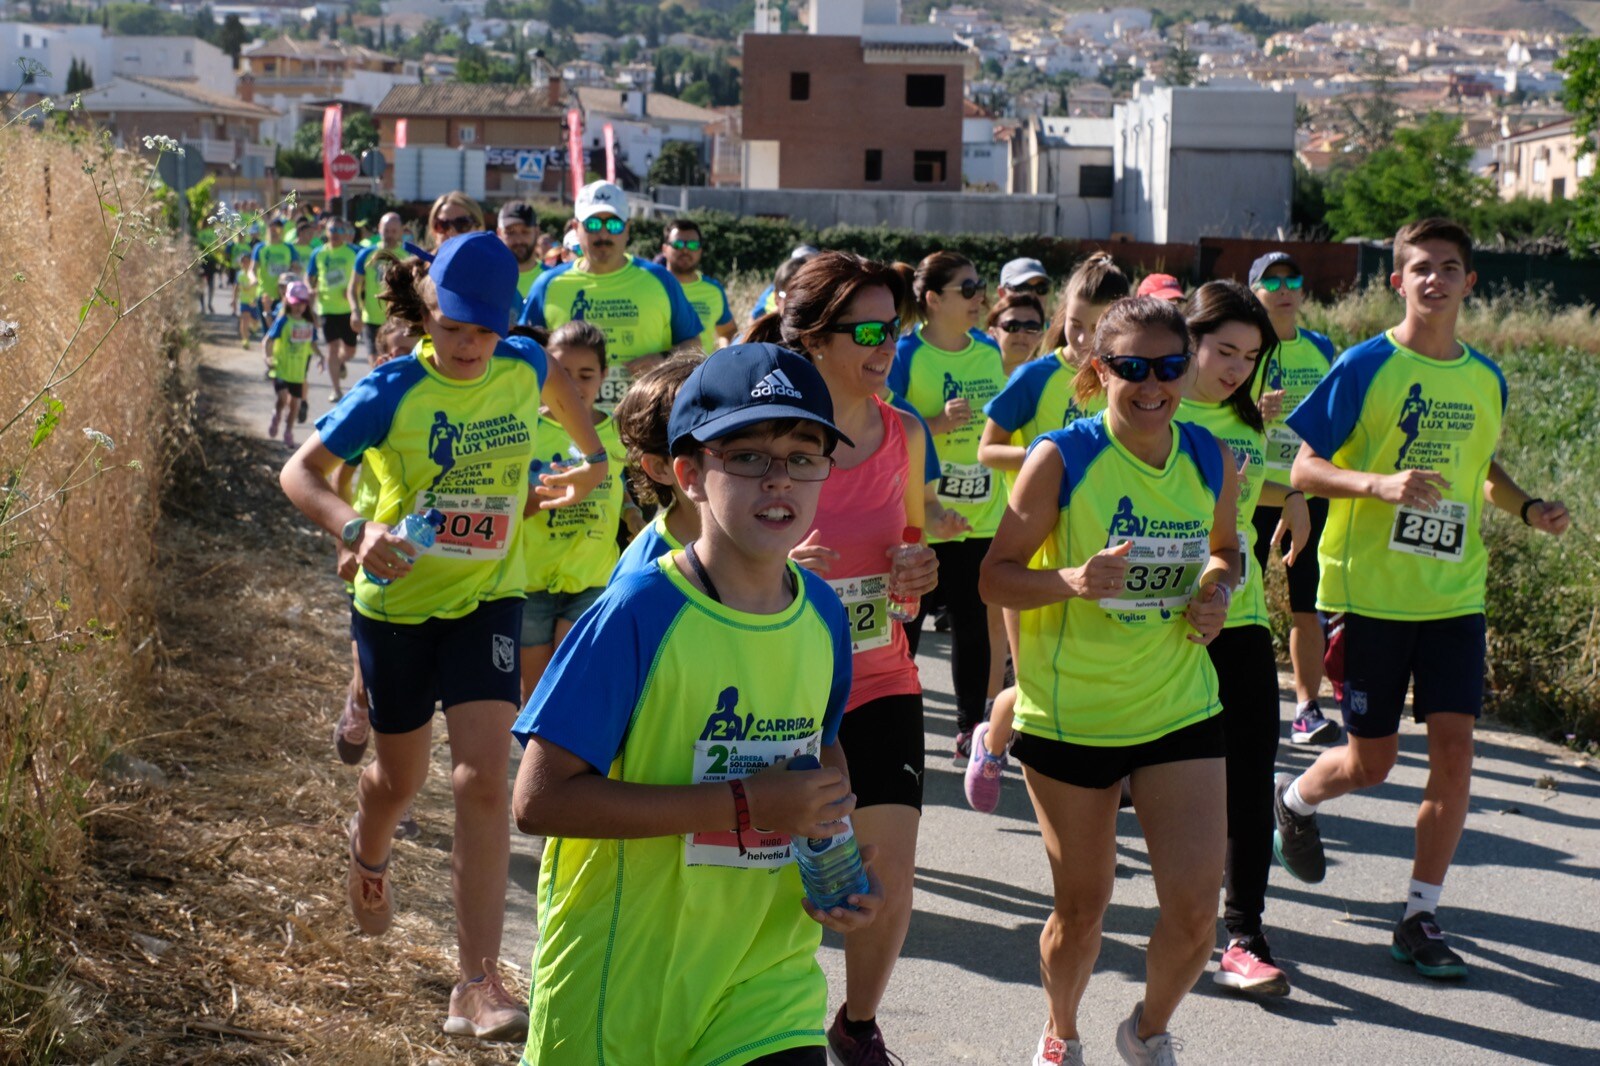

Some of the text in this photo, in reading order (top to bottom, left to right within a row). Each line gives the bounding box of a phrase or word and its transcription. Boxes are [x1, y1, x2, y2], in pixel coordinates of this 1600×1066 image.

[332, 163, 357, 172] STOP
[751, 385, 802, 399] adidas
[1434, 402, 1474, 411] CARRERA
[466, 414, 517, 432] CARRERA
[1422, 420, 1443, 429] LUX
[464, 422, 528, 442] SOLIDARIA
[455, 432, 531, 456] LUX MUNDI
[945, 475, 986, 496] 282
[1402, 514, 1457, 548] 295
[1126, 566, 1185, 592] 331
[756, 717, 815, 732] CARRERA
[760, 838, 782, 847] HUGO
[747, 851, 784, 860] helvetia
